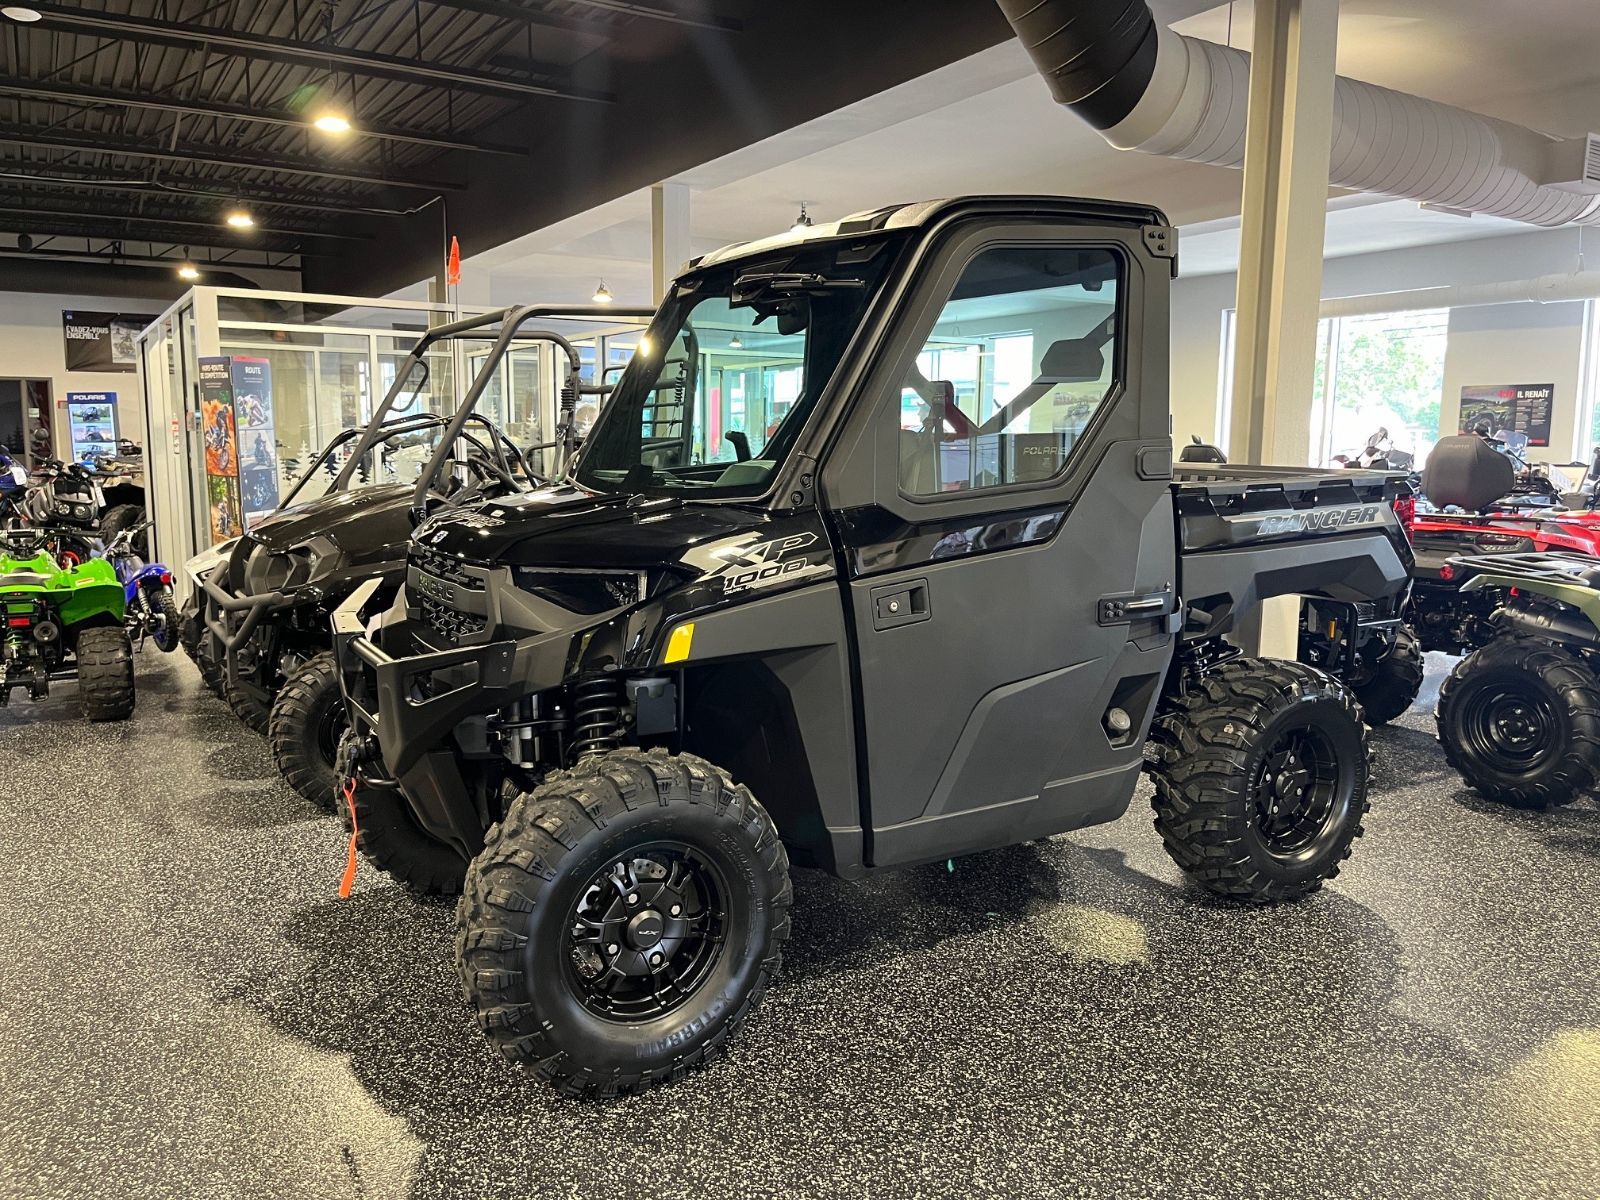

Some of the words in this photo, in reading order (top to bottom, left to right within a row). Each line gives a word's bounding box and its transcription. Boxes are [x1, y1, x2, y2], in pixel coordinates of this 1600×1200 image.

[67, 332, 100, 340] ENSEMBLE
[245, 366, 262, 375] ROUTE
[1517, 390, 1524, 399] IL
[1524, 388, 1550, 399] RENAÎT
[1256, 506, 1380, 535] RANGER
[696, 531, 819, 583] XP
[723, 557, 808, 591] 1000
